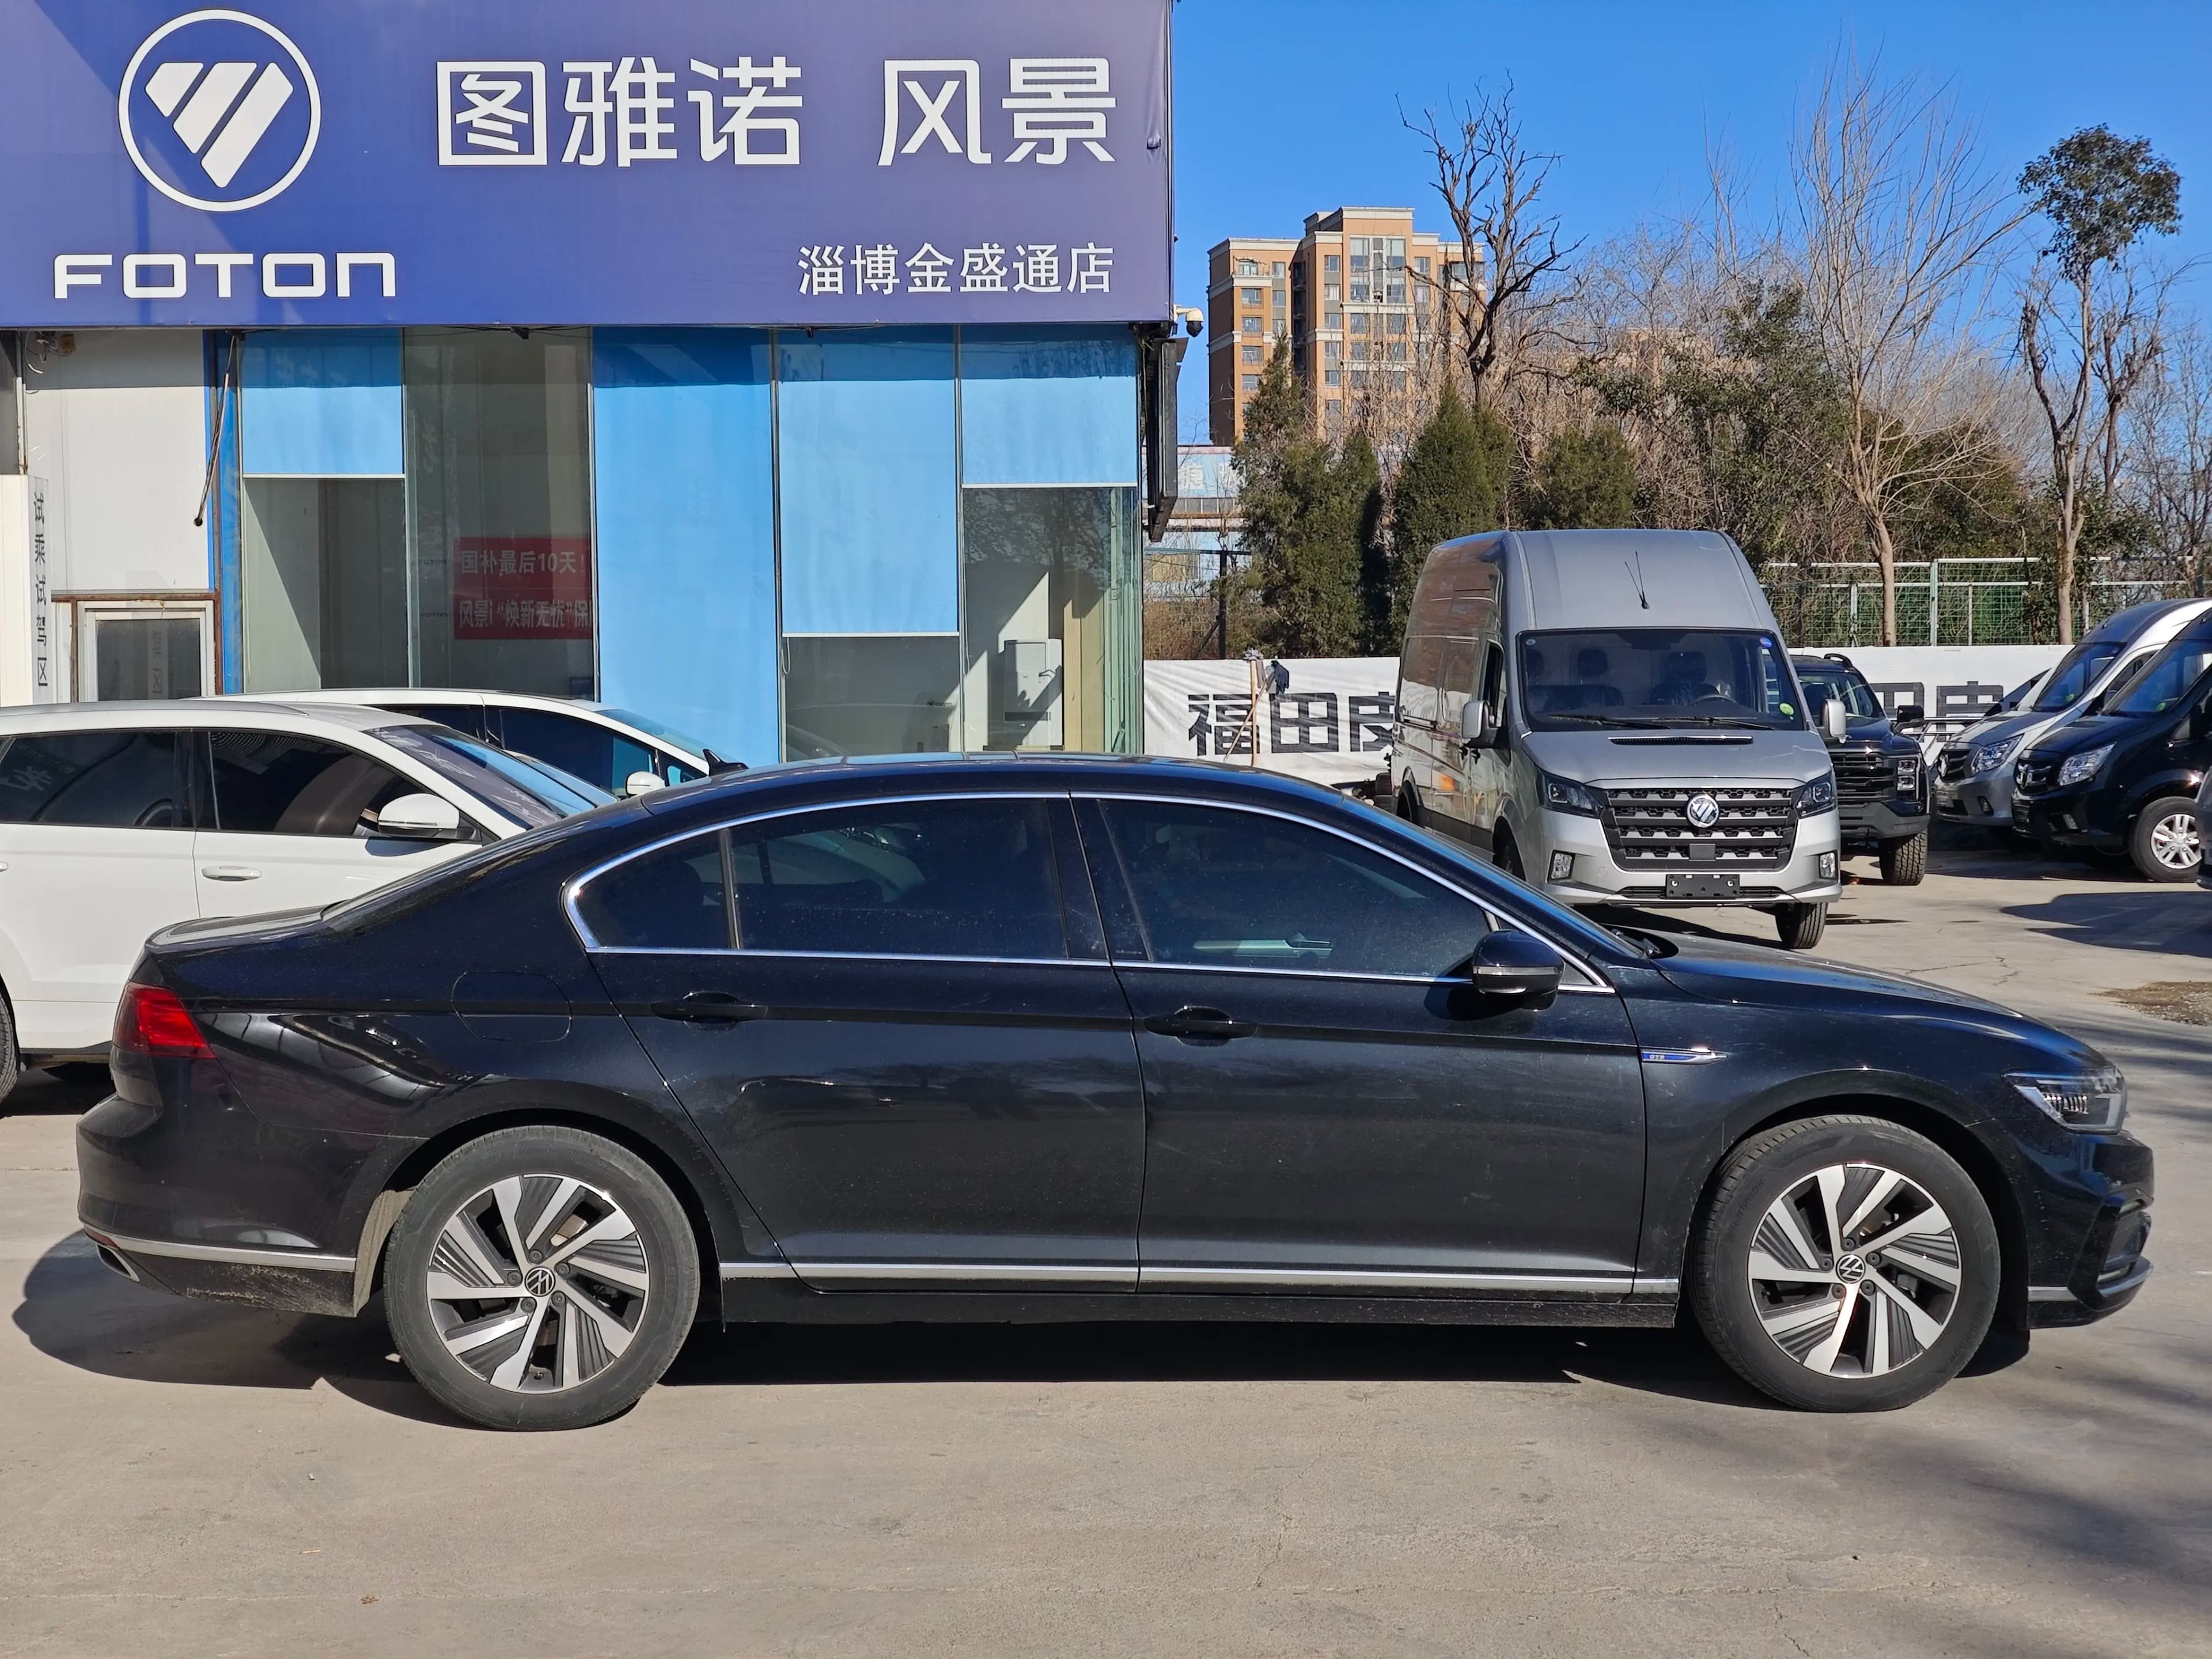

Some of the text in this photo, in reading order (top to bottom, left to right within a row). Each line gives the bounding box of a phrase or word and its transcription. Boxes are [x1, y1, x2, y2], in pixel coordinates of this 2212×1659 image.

[436, 55, 1117, 167] 图雅诺 风景
[54, 251, 397, 299] FOTON
[797, 241, 1115, 296] 淄博金盛通店
[33, 491, 48, 687] 试乘试驾区
